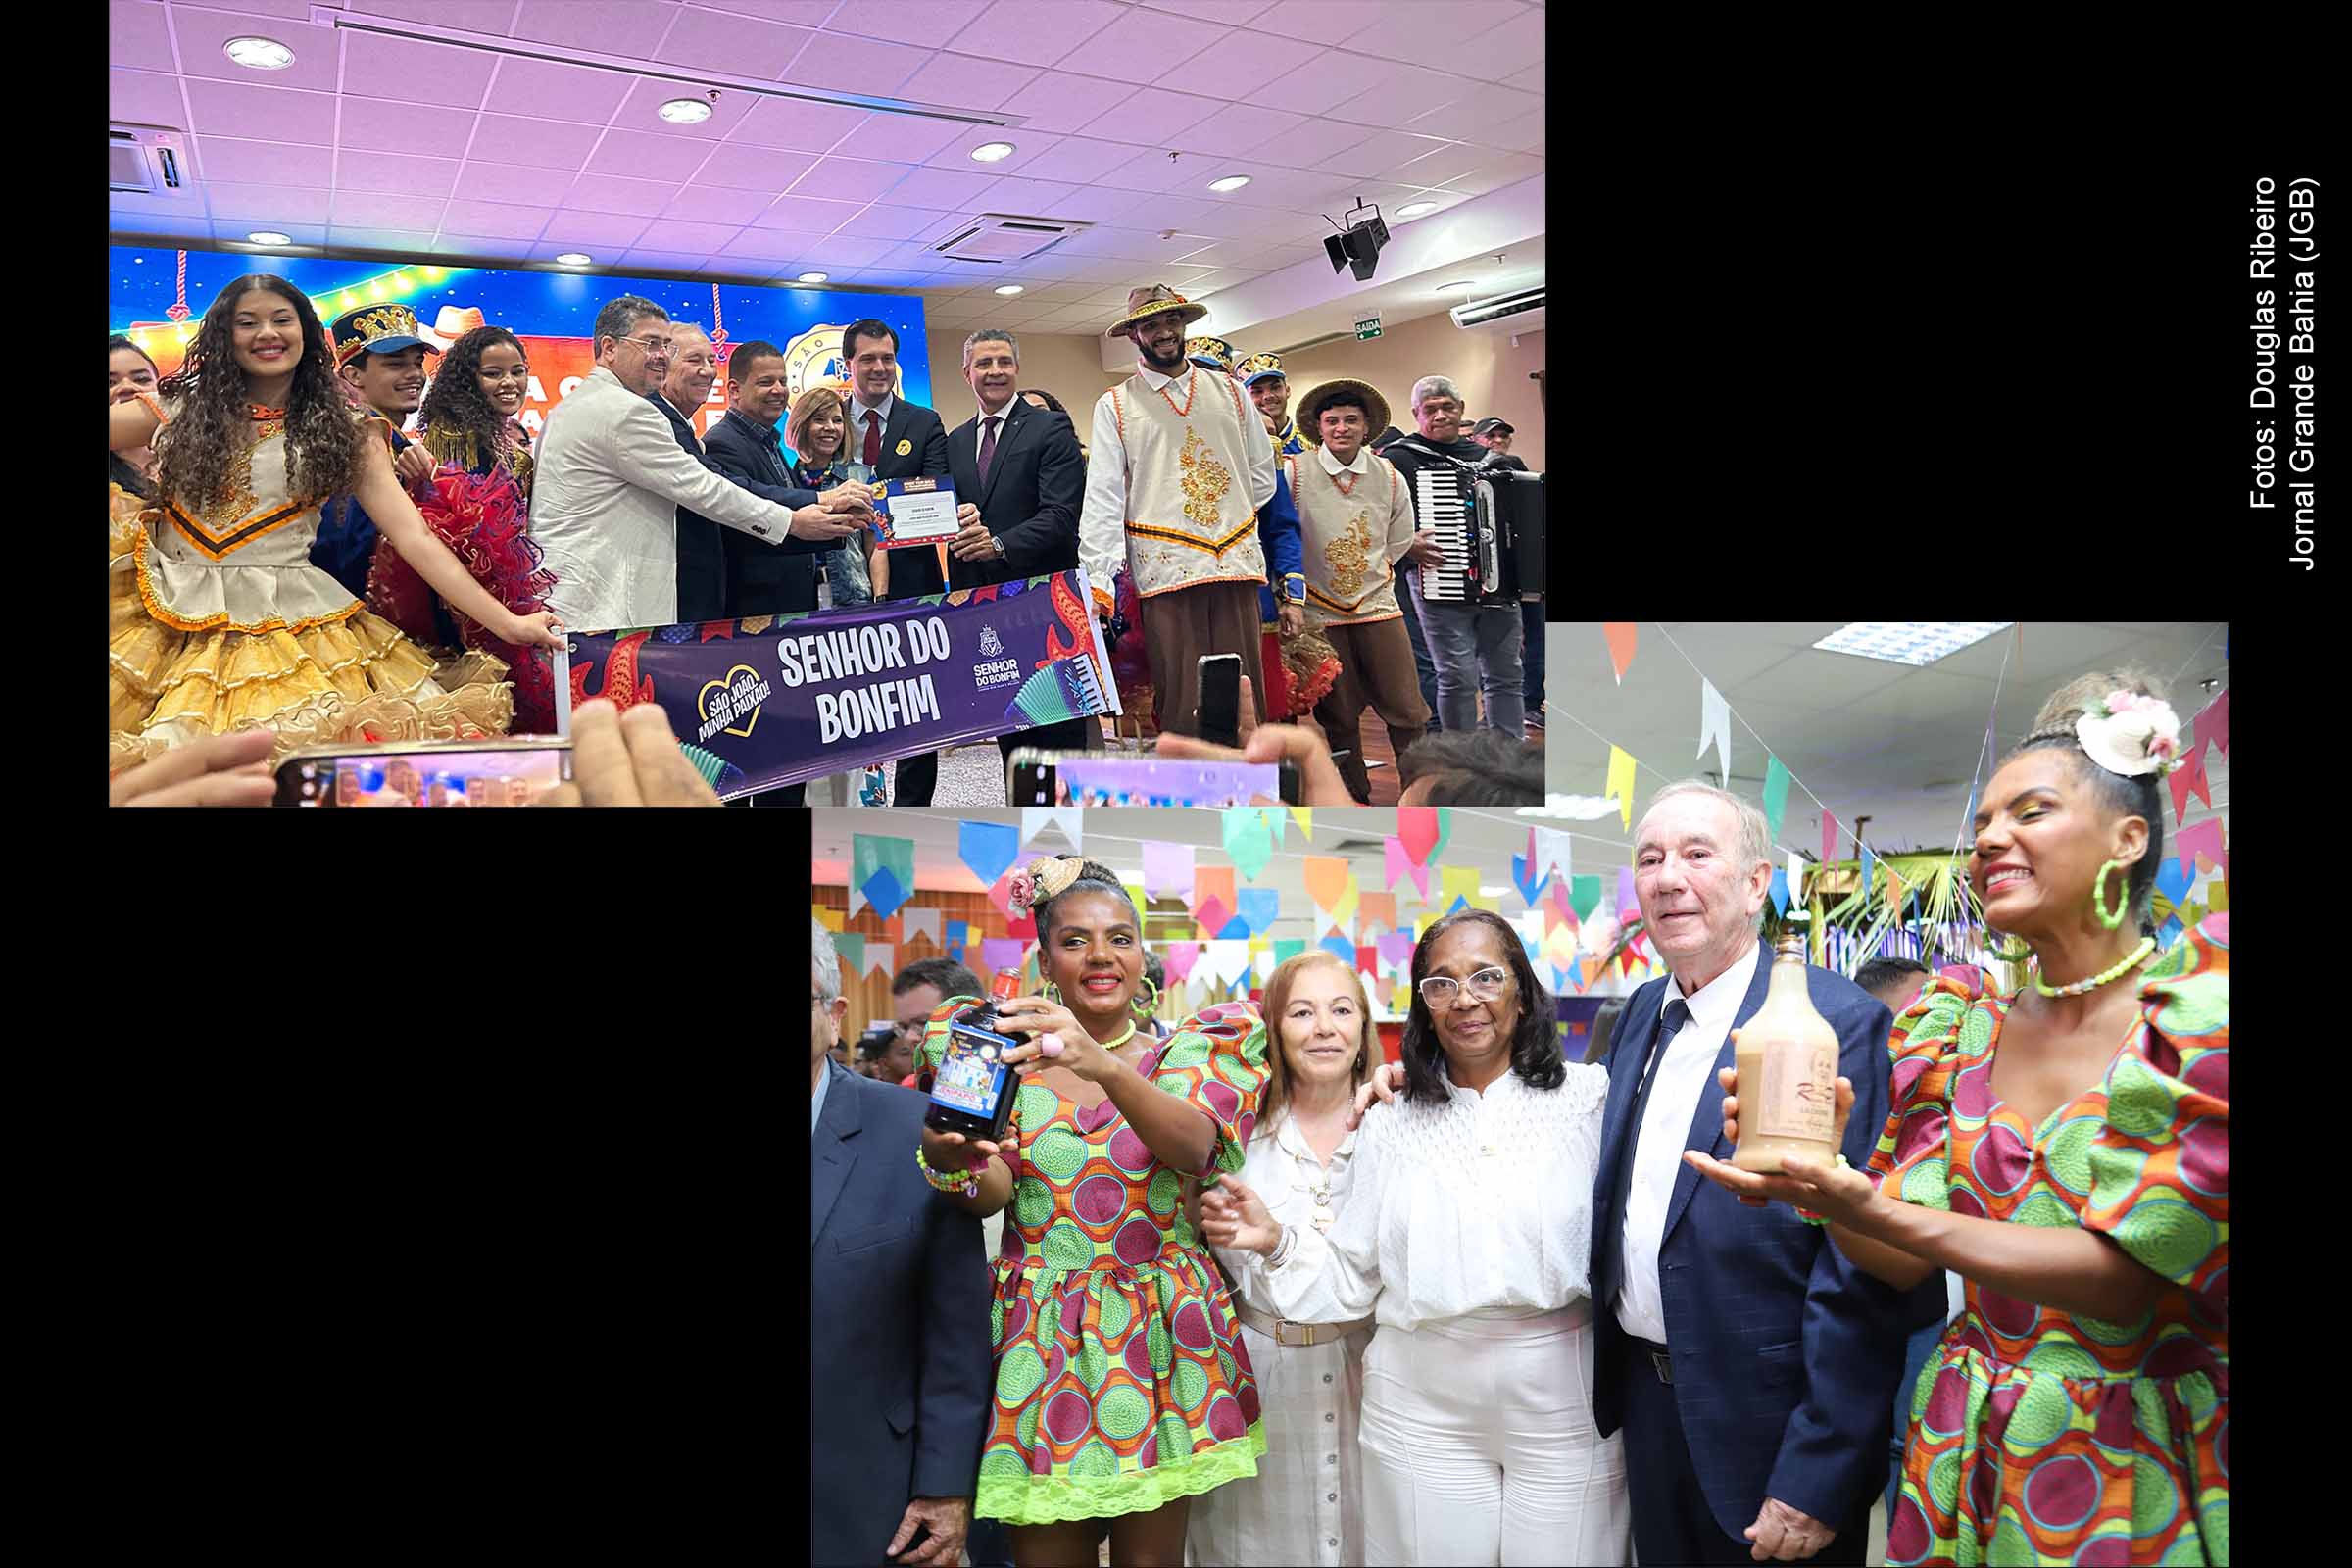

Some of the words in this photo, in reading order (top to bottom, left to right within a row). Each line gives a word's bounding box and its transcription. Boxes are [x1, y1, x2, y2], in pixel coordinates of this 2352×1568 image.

[777, 623, 906, 688] SENHOR
[906, 616, 951, 665] DO
[973, 658, 1018, 676] SENHOR
[708, 692, 731, 718] SÃO
[730, 674, 756, 704] JOÃO
[975, 676, 990, 687] DO
[698, 708, 735, 743] MINHA
[815, 674, 942, 744] BONFIM
